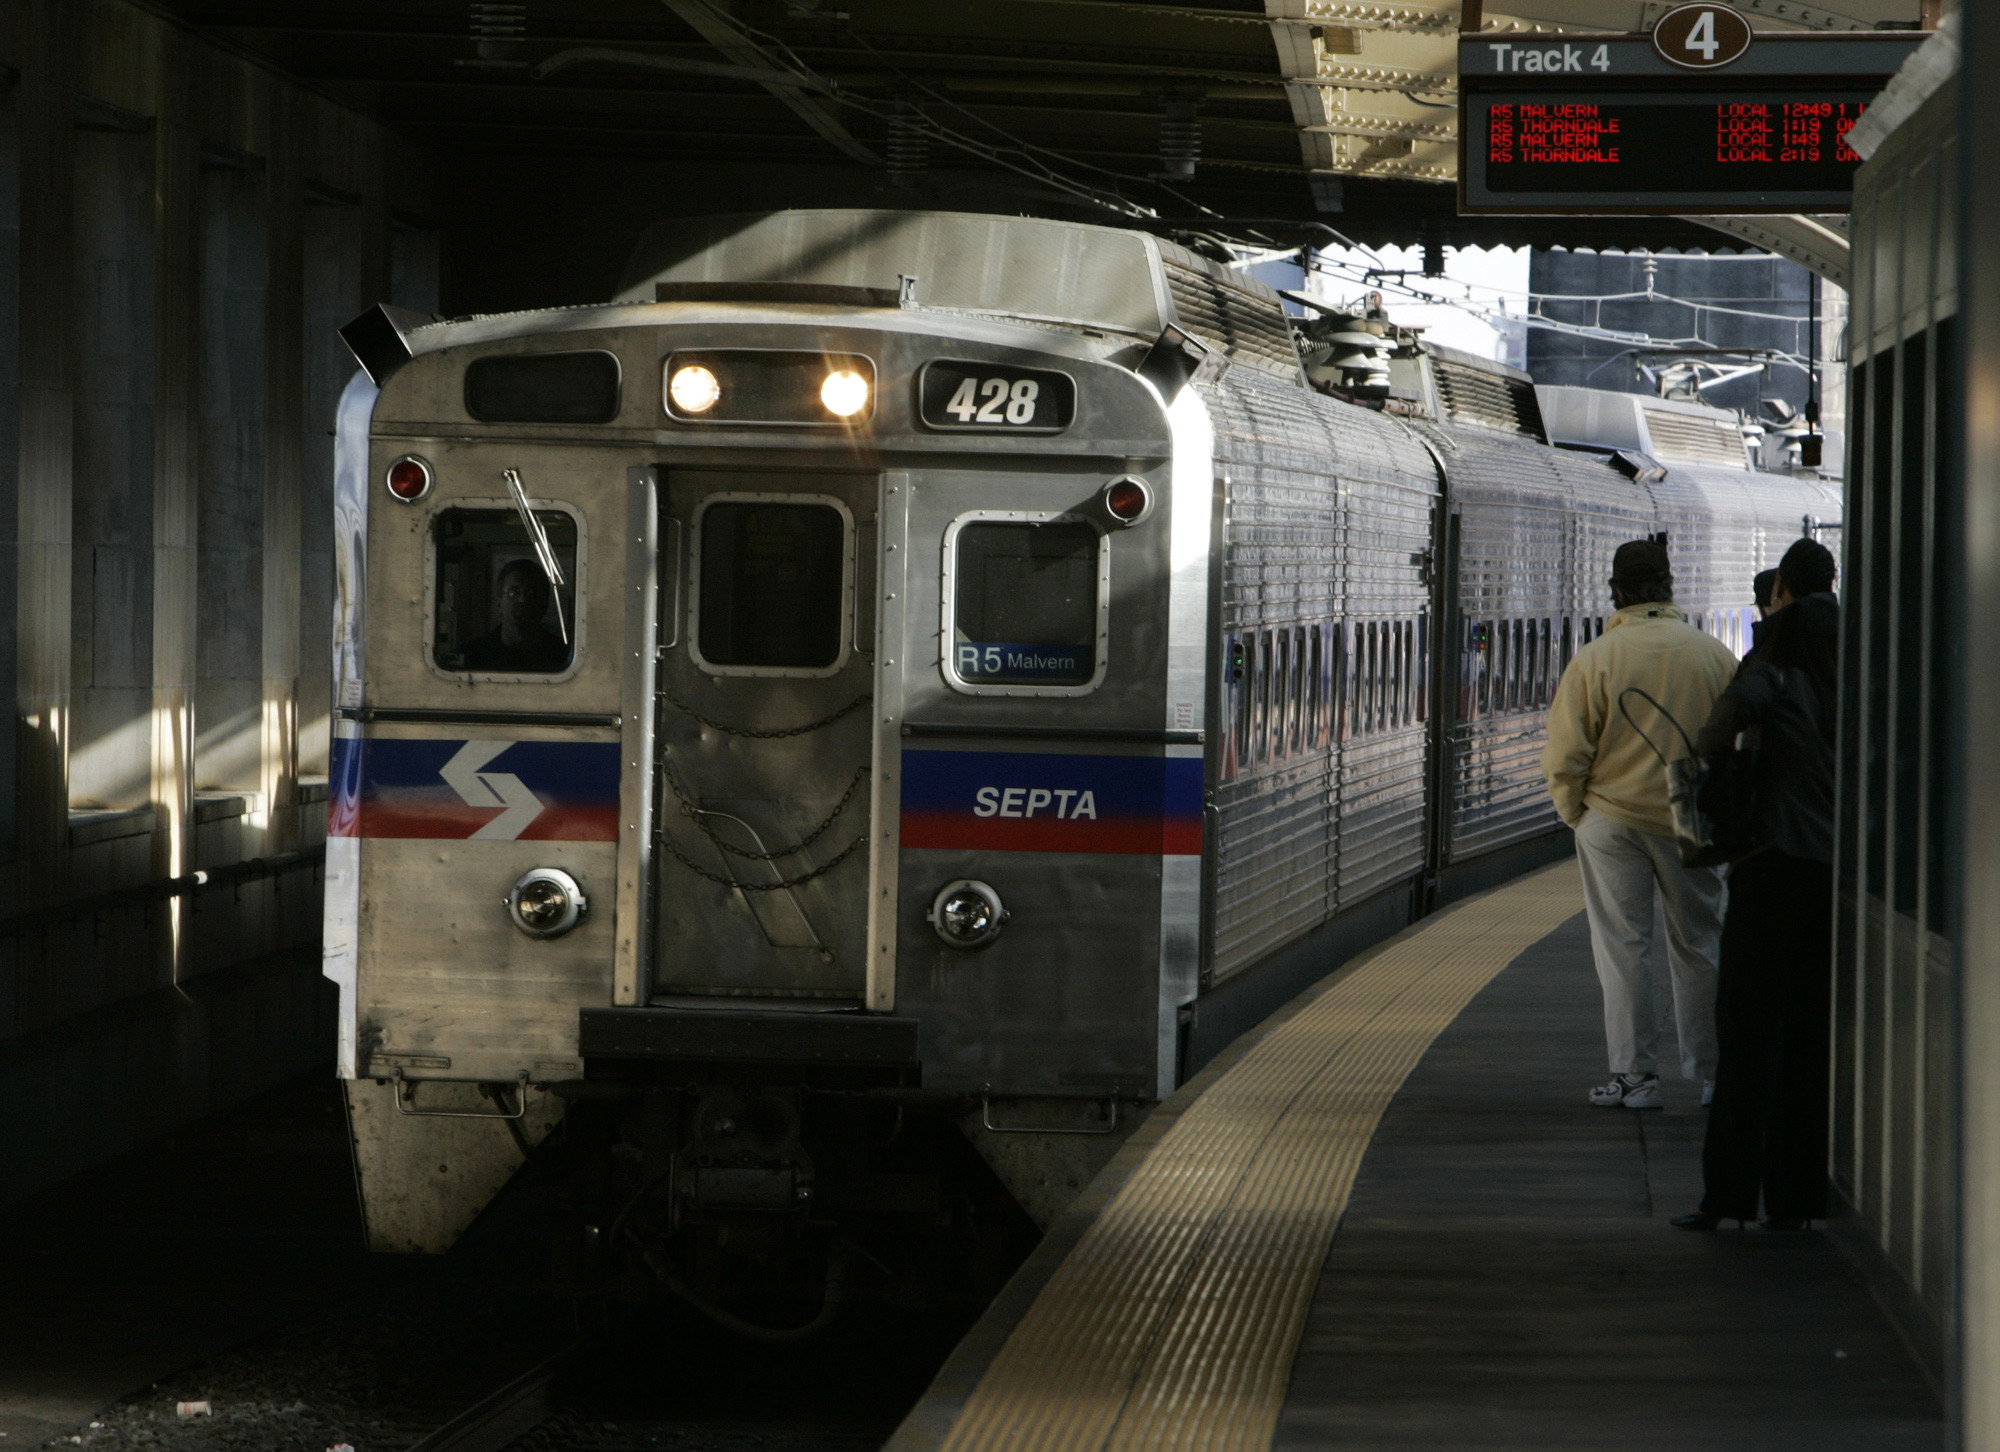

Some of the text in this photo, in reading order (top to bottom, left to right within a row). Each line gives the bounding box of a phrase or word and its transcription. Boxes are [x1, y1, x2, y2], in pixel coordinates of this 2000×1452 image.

[1685, 12, 1720, 60] 4
[1489, 44, 1610, 72] Track 4
[1490, 104, 1513, 118] R5
[1520, 104, 1598, 118] MALVERN
[1717, 104, 1773, 118] LOCAL
[1783, 104, 1832, 118] 12:49
[1490, 118, 1513, 133] R5
[1520, 118, 1620, 133] THORNDALE
[1717, 118, 1773, 133] LOCAL
[1783, 118, 1820, 133] 1:19
[1490, 133, 1513, 147] R5
[1520, 133, 1598, 147] MALVERN
[1717, 133, 1773, 147] LOCAL
[1783, 133, 1820, 147] 1:49
[1490, 147, 1513, 162] R5
[1520, 147, 1620, 162] THORNDALE
[1717, 147, 1773, 162] LOCAL
[1780, 147, 1820, 162] 2:19
[946, 378, 1039, 424] 428
[1007, 651, 1075, 670] Malvern
[973, 786, 1098, 820] SEPTA
